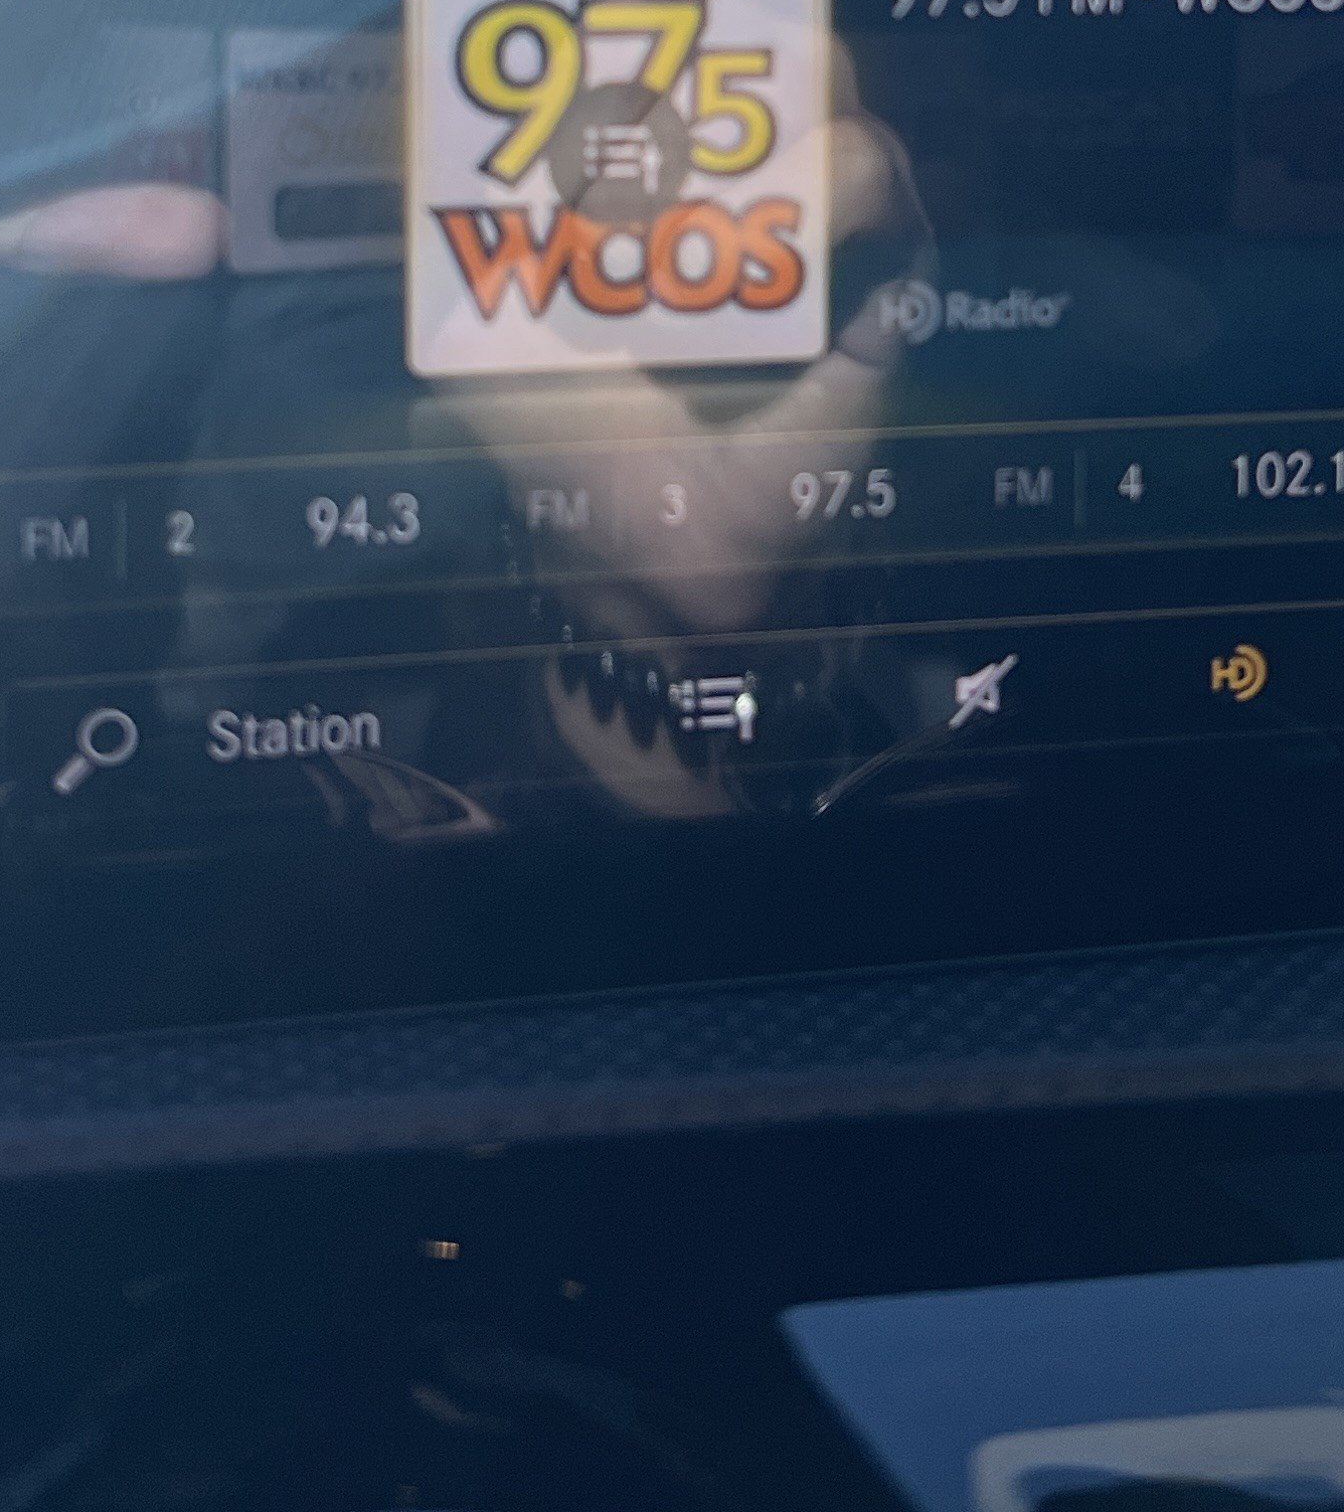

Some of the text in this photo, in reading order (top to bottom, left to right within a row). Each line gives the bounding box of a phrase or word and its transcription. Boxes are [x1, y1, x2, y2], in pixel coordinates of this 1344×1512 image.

[430, 196, 808, 322] WCOS
[660, 465, 1053, 526] 3 97.5 FM
[1117, 463, 1144, 503] 4
[20, 516, 89, 562] FM
[165, 509, 196, 558] 2
[306, 491, 422, 548] 94.3
[207, 701, 382, 763] Station
